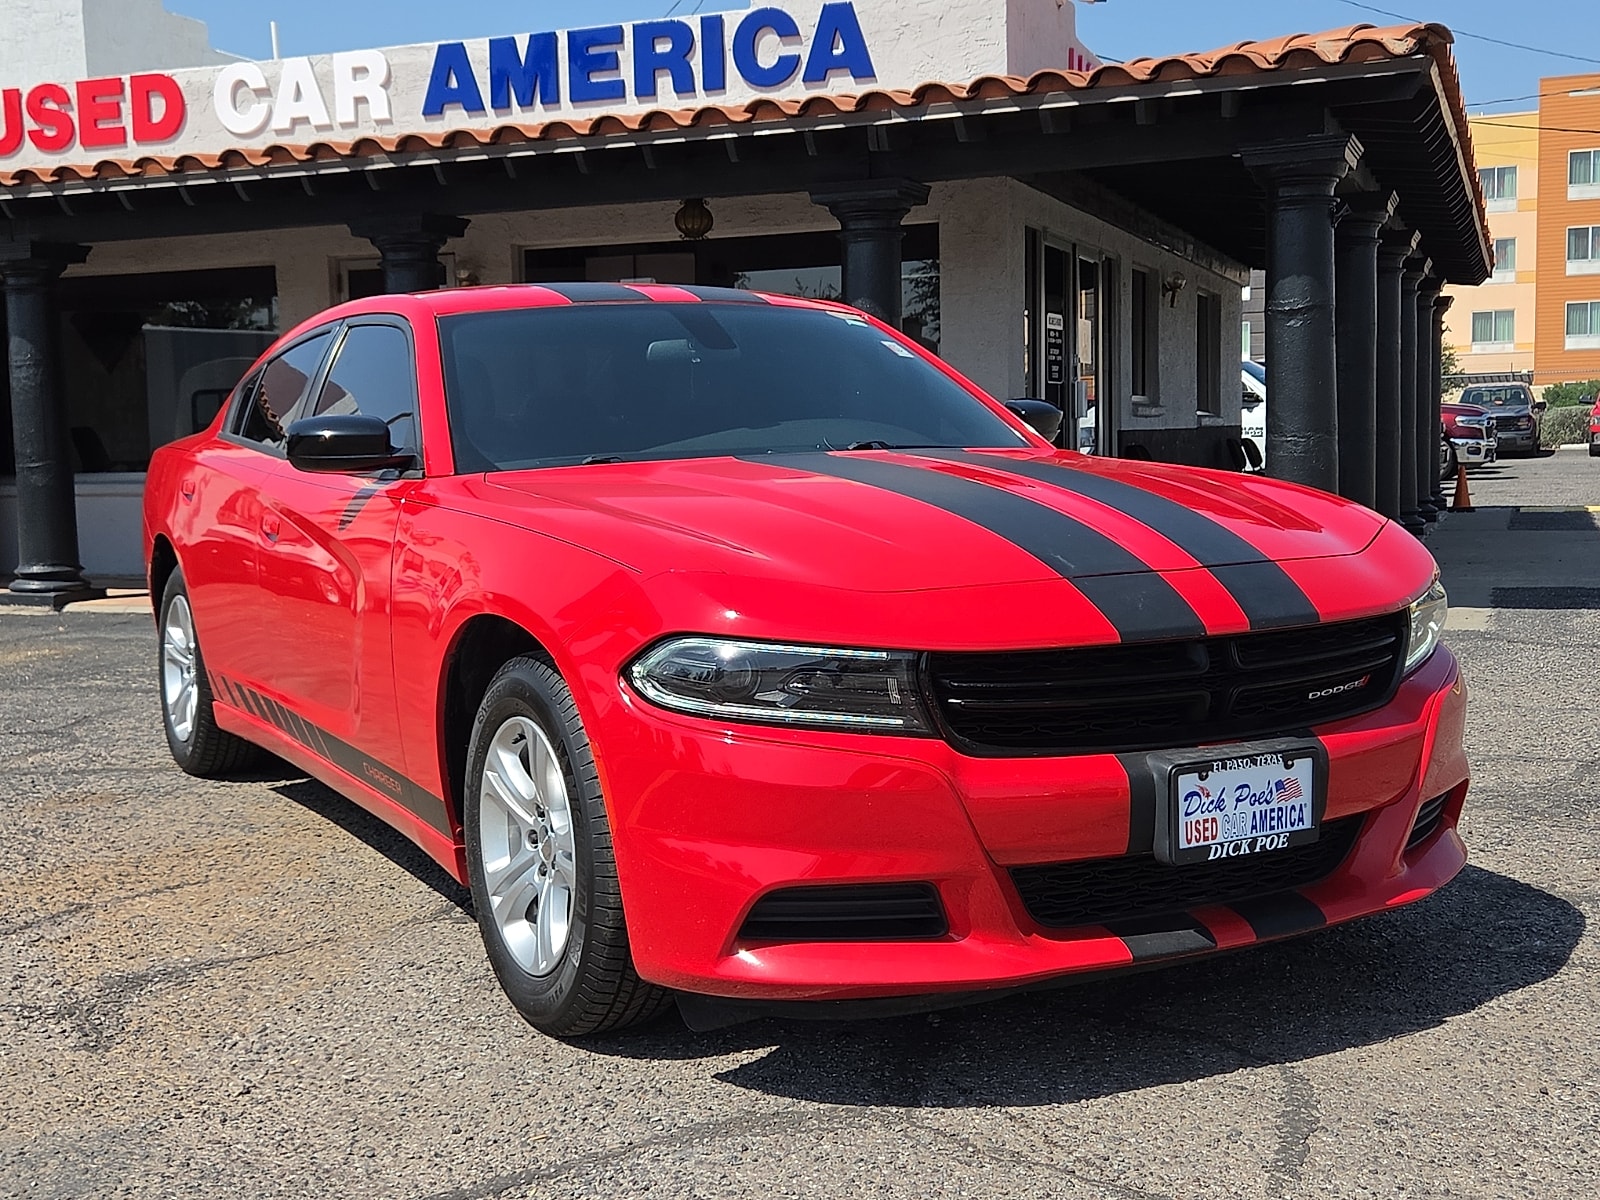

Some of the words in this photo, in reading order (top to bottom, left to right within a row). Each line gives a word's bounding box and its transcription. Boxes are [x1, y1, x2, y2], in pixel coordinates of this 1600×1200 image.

[0, 74, 185, 156] USED
[214, 50, 391, 134] CAR
[422, 2, 876, 117] AMERICA
[1308, 680, 1366, 700] DODGE
[1213, 761, 1226, 773] EL
[1227, 757, 1254, 770] PASO,
[1255, 754, 1283, 768] TEXAS
[1183, 786, 1227, 817] Dick
[1234, 780, 1274, 811] Poe's
[1184, 817, 1219, 845] USED
[1221, 811, 1248, 839] CAR
[1207, 838, 1253, 861] DICK
[1254, 832, 1290, 853] POE
